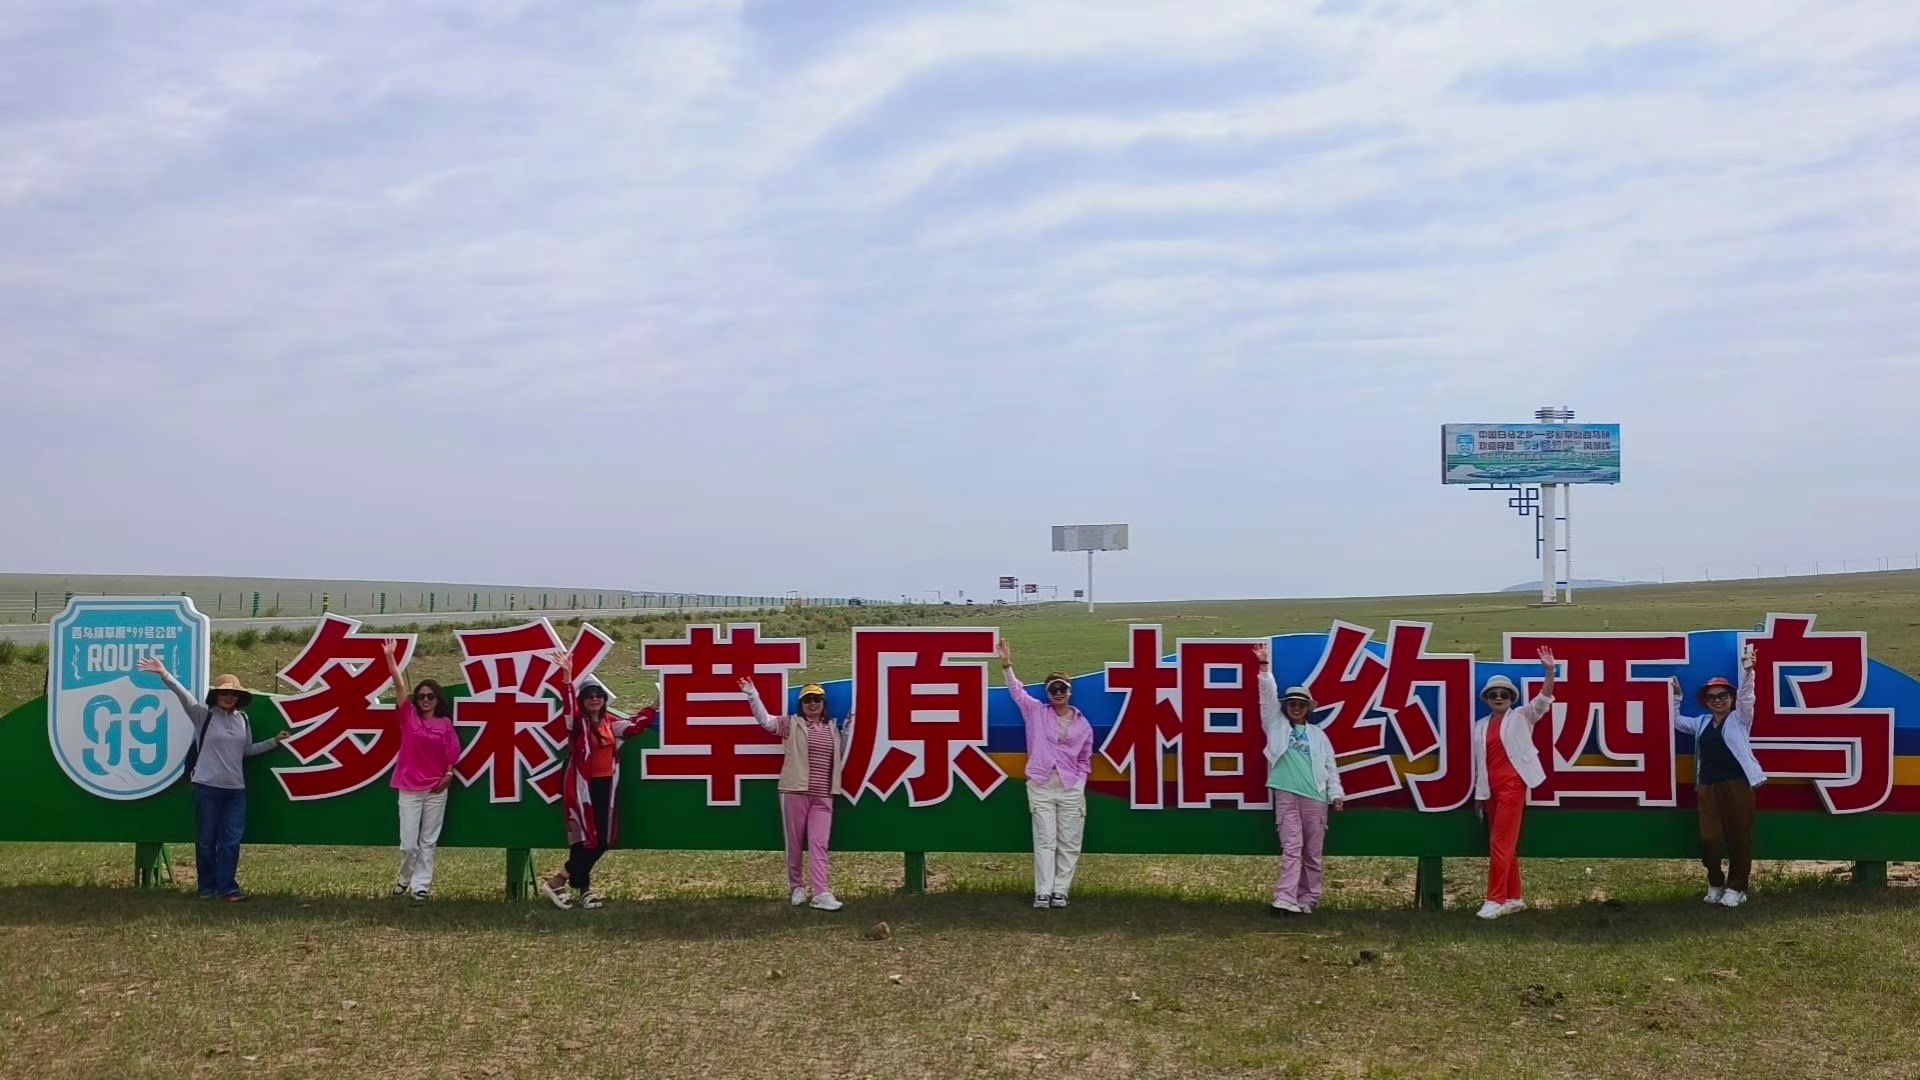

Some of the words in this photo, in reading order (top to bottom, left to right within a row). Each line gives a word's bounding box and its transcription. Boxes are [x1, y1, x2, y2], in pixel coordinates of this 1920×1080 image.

[87, 643, 165, 672] ROUTE
[82, 694, 168, 776] 99
[270, 612, 1008, 808] 多彩草原
[1100, 612, 1895, 814] 相约西乌
